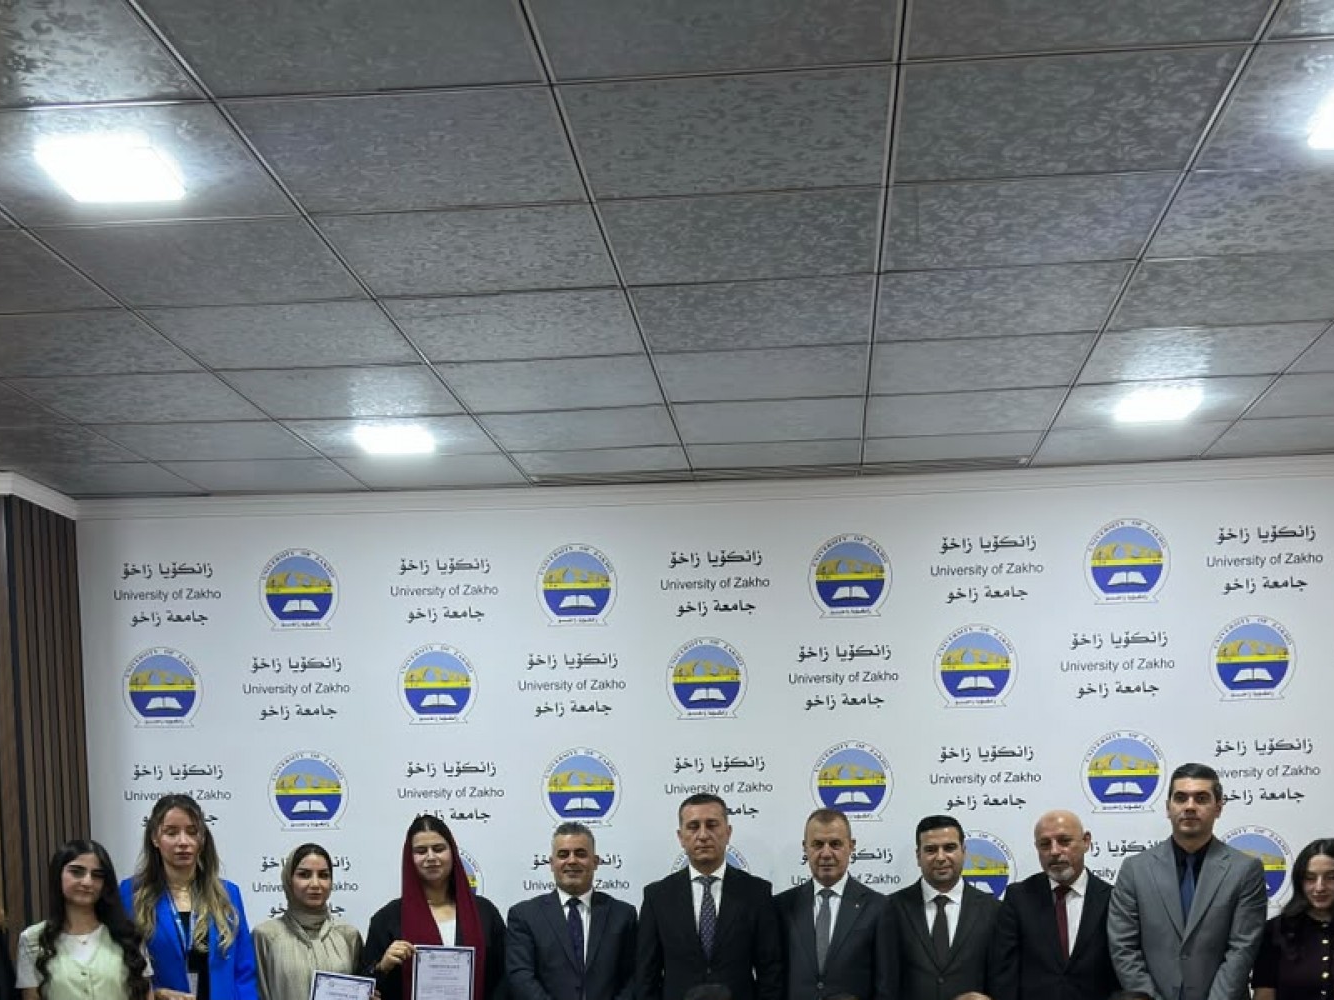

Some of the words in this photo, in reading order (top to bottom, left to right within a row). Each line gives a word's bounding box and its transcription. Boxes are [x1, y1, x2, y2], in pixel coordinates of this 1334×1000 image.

[1206, 554, 1267, 569] University
[1268, 552, 1283, 566] of
[1283, 551, 1324, 566] Zakho
[930, 564, 989, 579] University
[990, 562, 1004, 576] of
[1005, 561, 1045, 575] Zakho
[390, 584, 447, 600] University
[448, 583, 461, 597] of
[461, 583, 500, 596] Zakho
[660, 577, 717, 593] University
[718, 576, 732, 591] of
[732, 575, 771, 590] Zakho
[983, 584, 1029, 601] جامعة
[1221, 577, 1257, 596] زاخو
[1261, 575, 1309, 593] جامعة
[113, 589, 170, 603] University
[171, 587, 184, 601] of
[185, 587, 222, 601] Zakho
[944, 587, 980, 605] زاخو
[405, 607, 439, 625] زاخو
[441, 605, 486, 623] جامعة
[675, 600, 709, 618] زاخو
[711, 599, 757, 616] جامعة
[130, 611, 162, 628] زاخو
[165, 609, 209, 626] جامعة
[1060, 659, 1120, 674] University
[1121, 657, 1136, 671] of
[1136, 657, 1176, 671] Zakho
[517, 679, 574, 694] University
[575, 677, 588, 691] of
[589, 677, 627, 691] Zakho
[788, 670, 845, 686] University
[846, 670, 860, 684] of
[860, 669, 900, 683] Zakho
[241, 681, 299, 698] University
[300, 681, 313, 695] of
[314, 681, 352, 695] Zakho
[1075, 682, 1110, 700] زاخو
[1114, 679, 1160, 698] جامعة
[533, 700, 566, 718] زاخو
[568, 699, 613, 716] جامعة
[803, 693, 837, 711] زاخو
[840, 692, 886, 709] جامعة
[258, 704, 291, 721] زاخو
[294, 703, 339, 720] جامعة
[929, 772, 988, 788] University
[988, 771, 1003, 785] of
[1004, 769, 1042, 784] Zakho
[1266, 764, 1279, 778] of
[1281, 764, 1322, 777] Zakho
[197, 789, 232, 801] Zakho
[396, 786, 454, 801] University
[454, 785, 467, 799] of
[468, 785, 505, 799] Zakho
[664, 783, 720, 796] University
[722, 781, 735, 793] of
[736, 781, 773, 793] Zakho
[1259, 786, 1305, 804] جامعة
[943, 794, 979, 812] زاخو
[981, 792, 1027, 810] جامعة
[449, 808, 491, 824] جامعة
[251, 882, 284, 893] Unive
[523, 879, 556, 891] Unive
[595, 879, 630, 890] Zakho
[864, 873, 902, 885] Zakho
